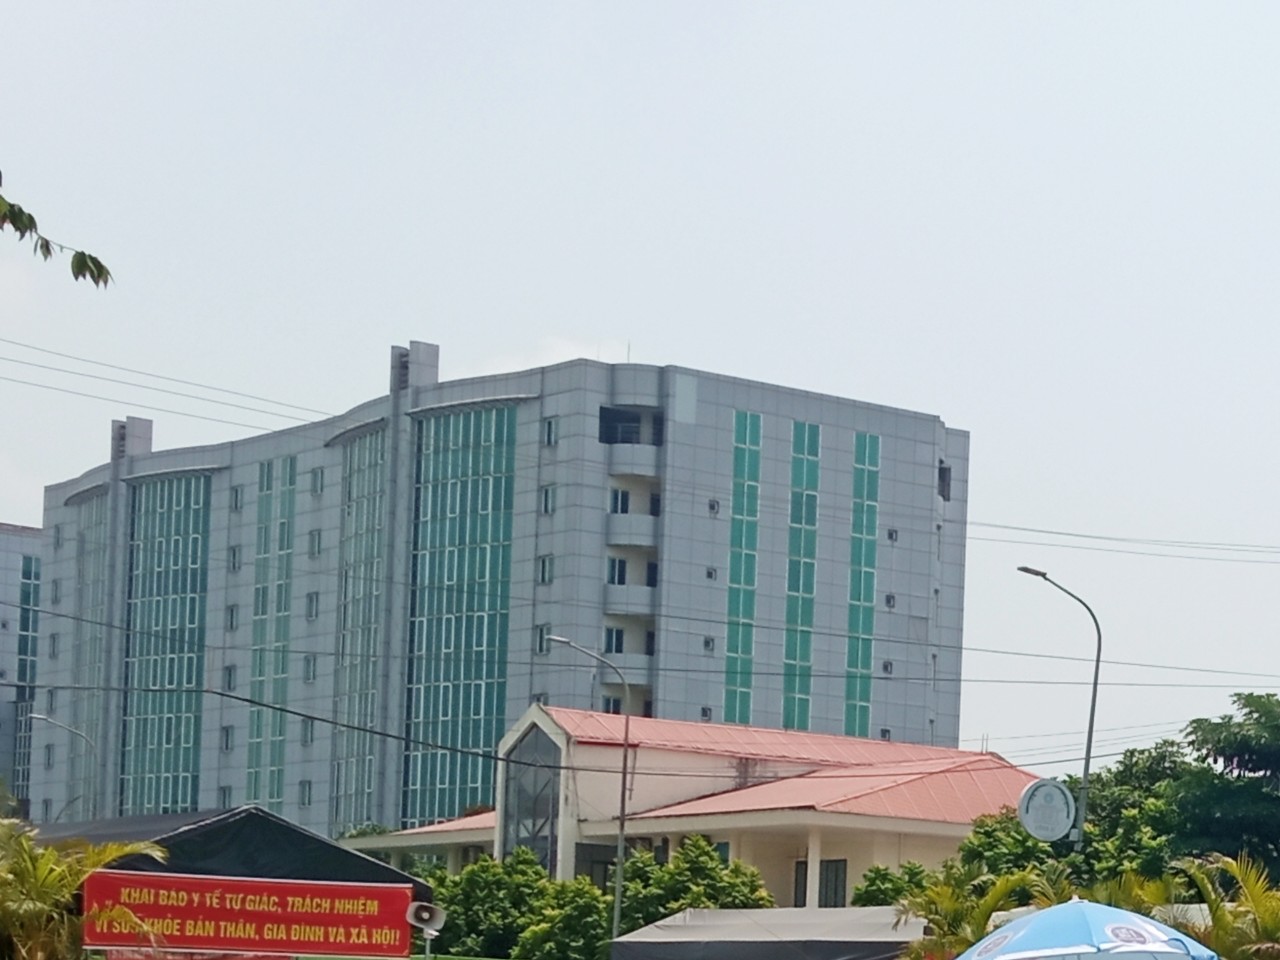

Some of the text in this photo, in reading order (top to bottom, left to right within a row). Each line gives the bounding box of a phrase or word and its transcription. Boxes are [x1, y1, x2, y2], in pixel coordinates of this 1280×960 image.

[121, 887, 378, 919] KHAI BÁO Y TẾ TỰ GIÁC, TRÁCH NHIỆM
[219, 918, 259, 940] THÂN,
[264, 923, 287, 941] GIA
[291, 921, 324, 942] ĐÌNH
[328, 924, 346, 943] VÀ
[350, 924, 369, 944] XÃ
[372, 926, 400, 948] HỘI!
